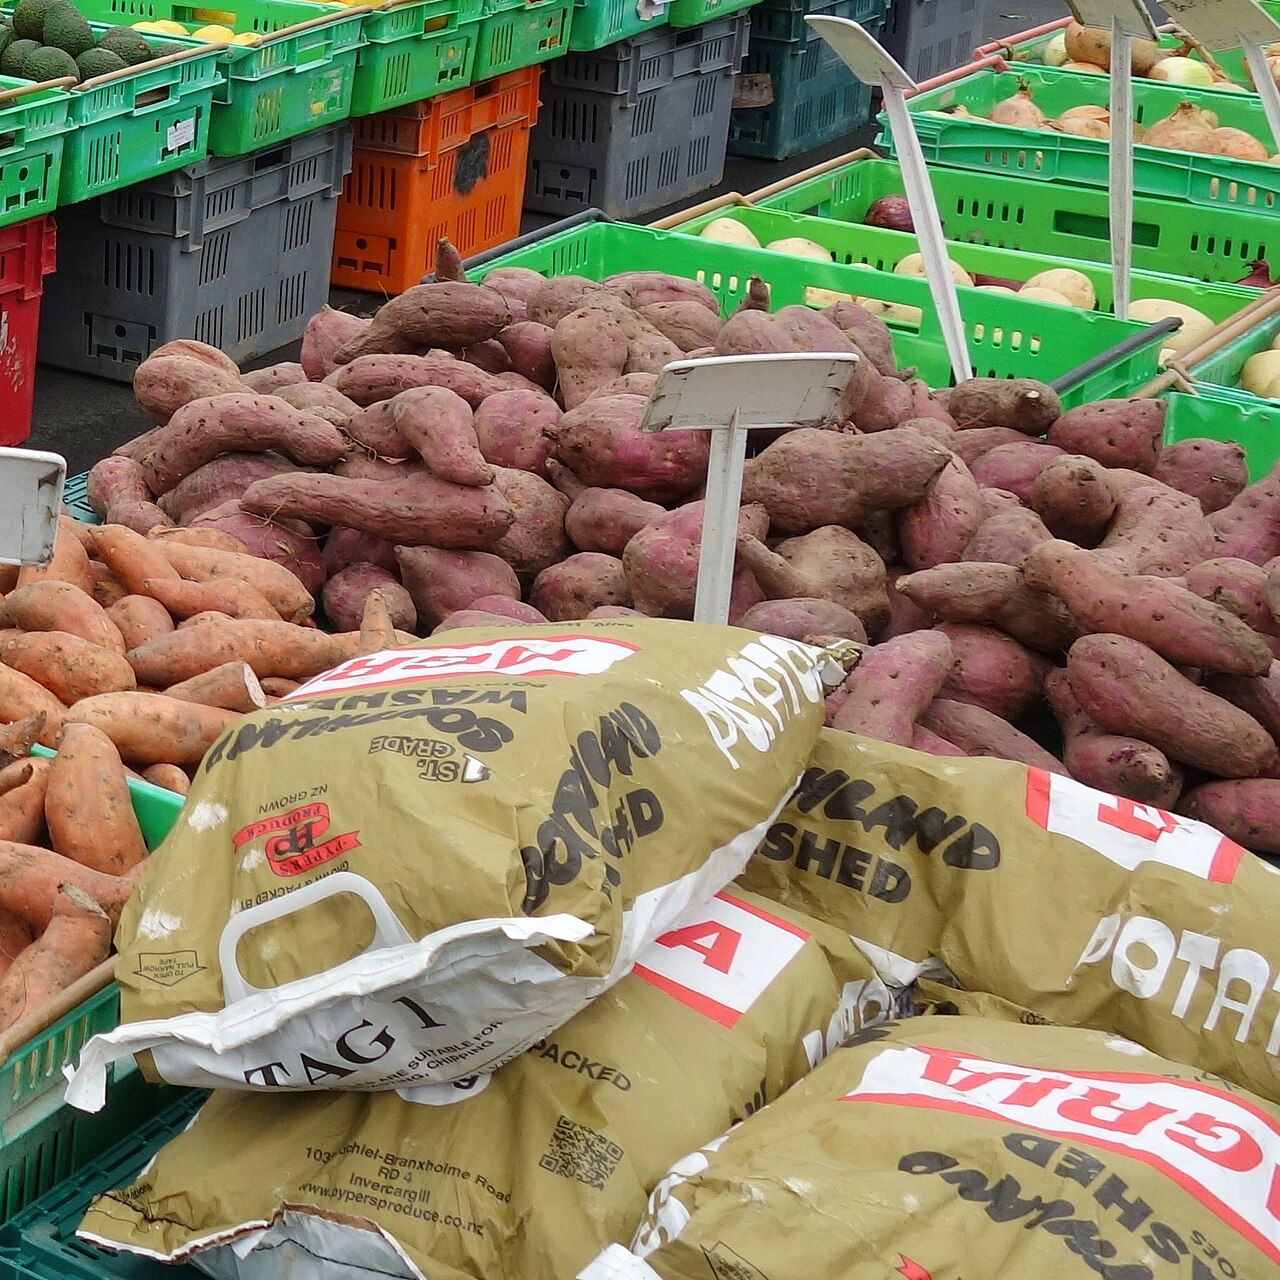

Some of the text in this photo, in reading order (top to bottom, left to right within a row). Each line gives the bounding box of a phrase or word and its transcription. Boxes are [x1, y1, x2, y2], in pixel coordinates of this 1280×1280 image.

[368, 735, 455, 758] GRADE
[258, 783, 328, 815] NZ GROWN
[246, 803, 323, 839] PRODUCE
[761, 820, 912, 904] SHED
[239, 897, 254, 912] BY
[244, 1019, 397, 1088] TAG
[408, 1033, 484, 1070] SUITABLE
[474, 1020, 504, 1044] FOR
[427, 1039, 495, 1071] CHIPPING
[920, 1053, 1280, 1217] GRIA
[349, 1172, 431, 1204] Invercargill
[378, 1166, 401, 1181] RD
[473, 1173, 512, 1203] Road
